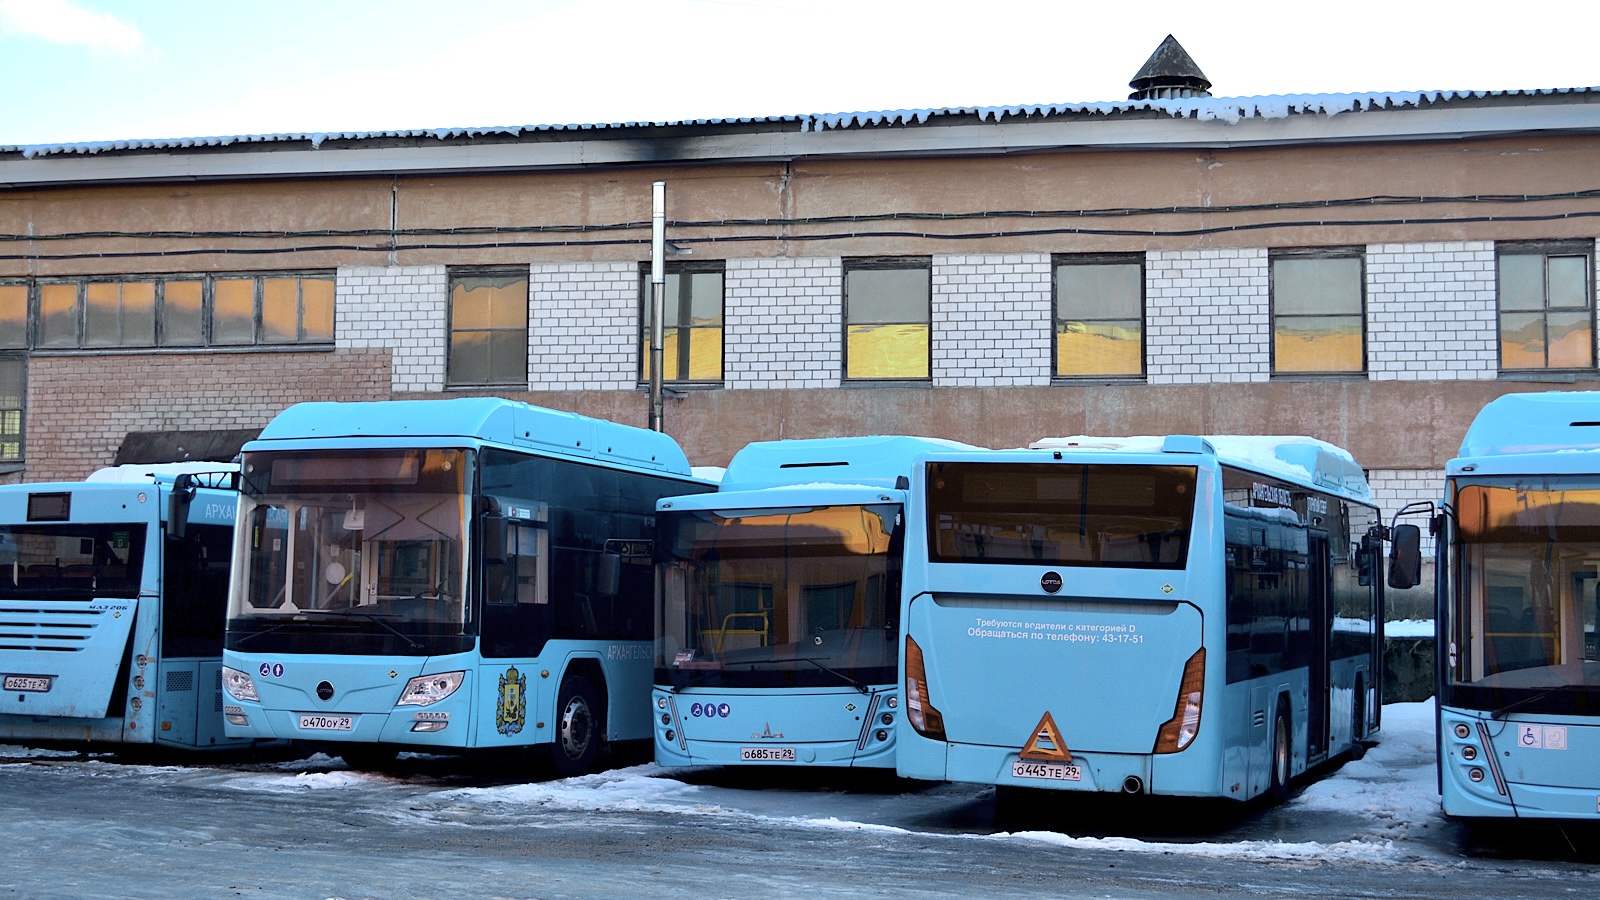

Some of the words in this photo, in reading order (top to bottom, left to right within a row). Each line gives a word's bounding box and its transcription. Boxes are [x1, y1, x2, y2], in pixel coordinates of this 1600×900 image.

[976, 618, 1023, 631] Требуются
[1024, 621, 1066, 631] водители
[1075, 623, 1127, 634] категорией
[1129, 624, 1136, 633] D
[967, 627, 1028, 640] Обращаться
[1031, 632, 1044, 640] по
[1046, 630, 1100, 644] телефону:
[1102, 633, 1144, 644] 43-17-51
[340, 718, 350, 726] 29
[782, 749, 792, 758] 29
[1065, 766, 1077, 776] 29
